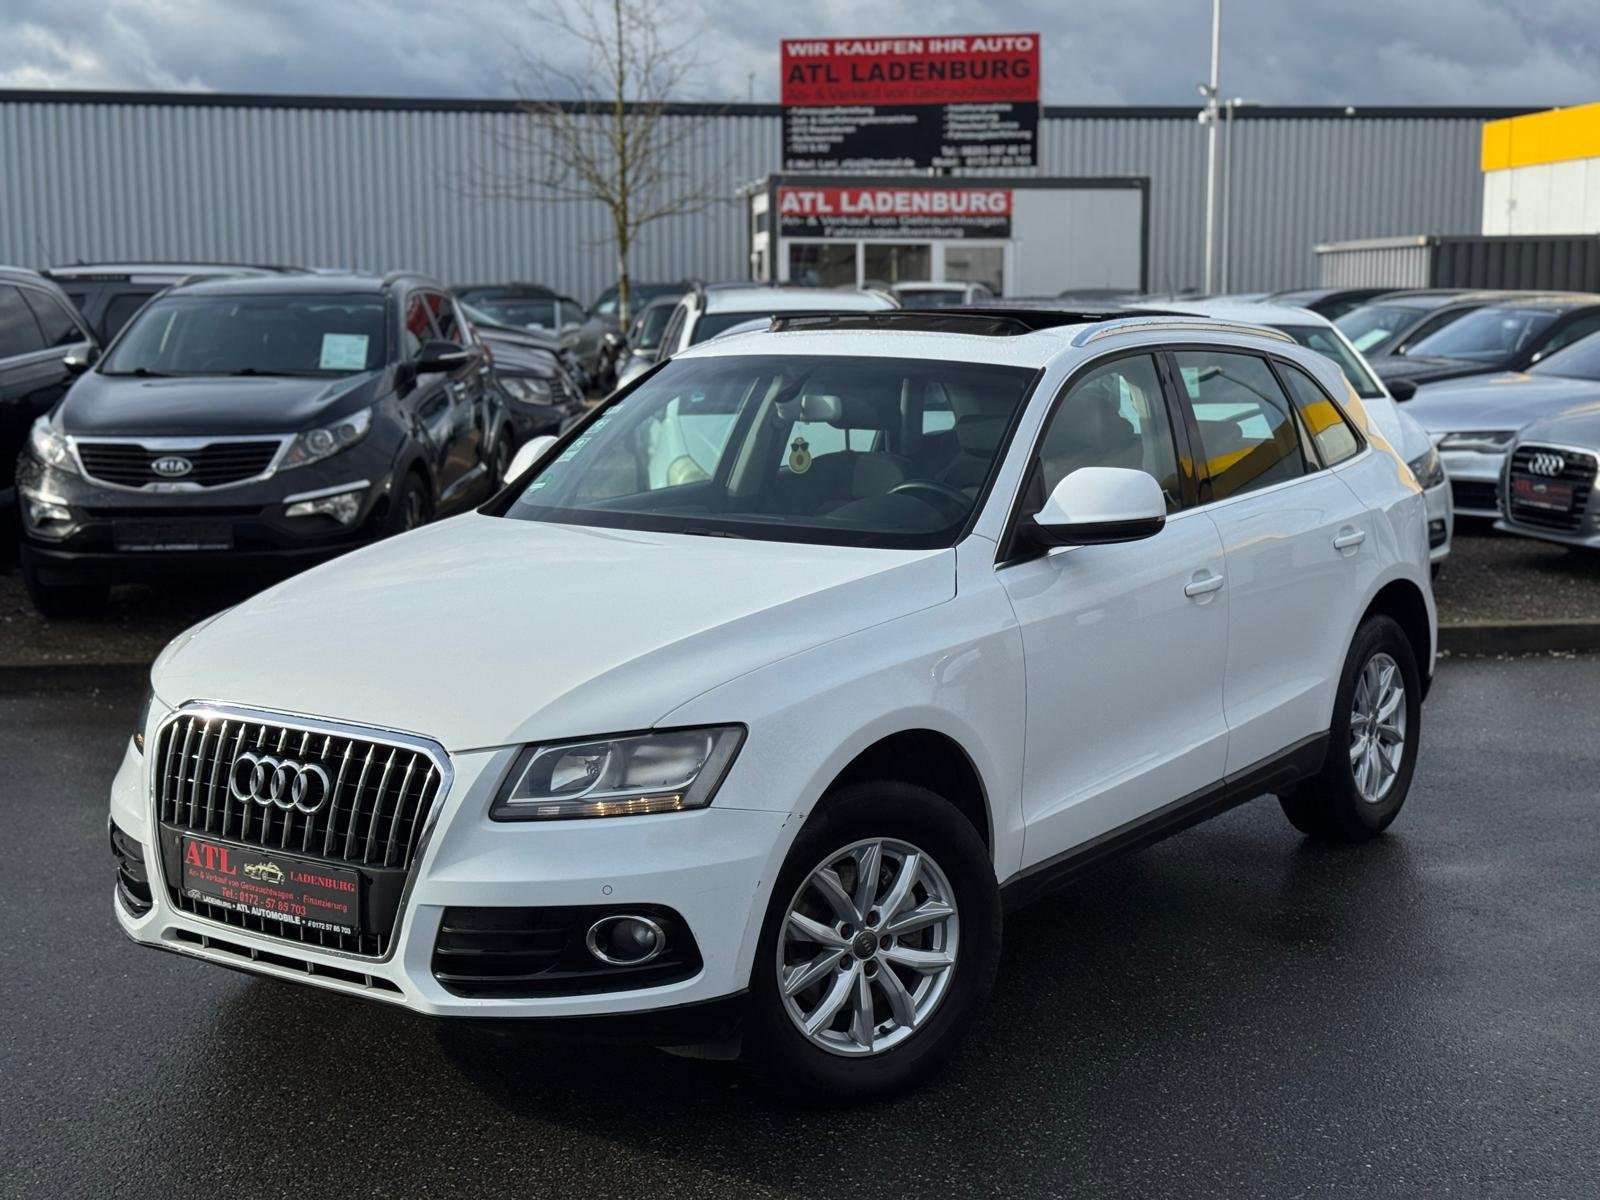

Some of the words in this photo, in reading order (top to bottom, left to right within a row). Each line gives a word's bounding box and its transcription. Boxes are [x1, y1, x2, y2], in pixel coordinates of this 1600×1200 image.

[787, 42, 830, 56] WIR
[834, 40, 924, 55] KAUFEN
[929, 38, 966, 53] IHR
[971, 37, 1033, 52] AUTO
[788, 63, 839, 84] ATL
[852, 59, 1030, 82] LADENBURG
[782, 192, 832, 212] ATL
[840, 192, 1007, 212] LADENBURG
[159, 460, 185, 471] KIA
[185, 841, 237, 875] ATL
[290, 871, 356, 892] LADENBURG
[236, 903, 251, 914] ATL
[251, 906, 301, 925] AUTOMOBILE
[239, 892, 259, 906] 0172
[265, 899, 276, 909] 57
[290, 904, 307, 916] 703
